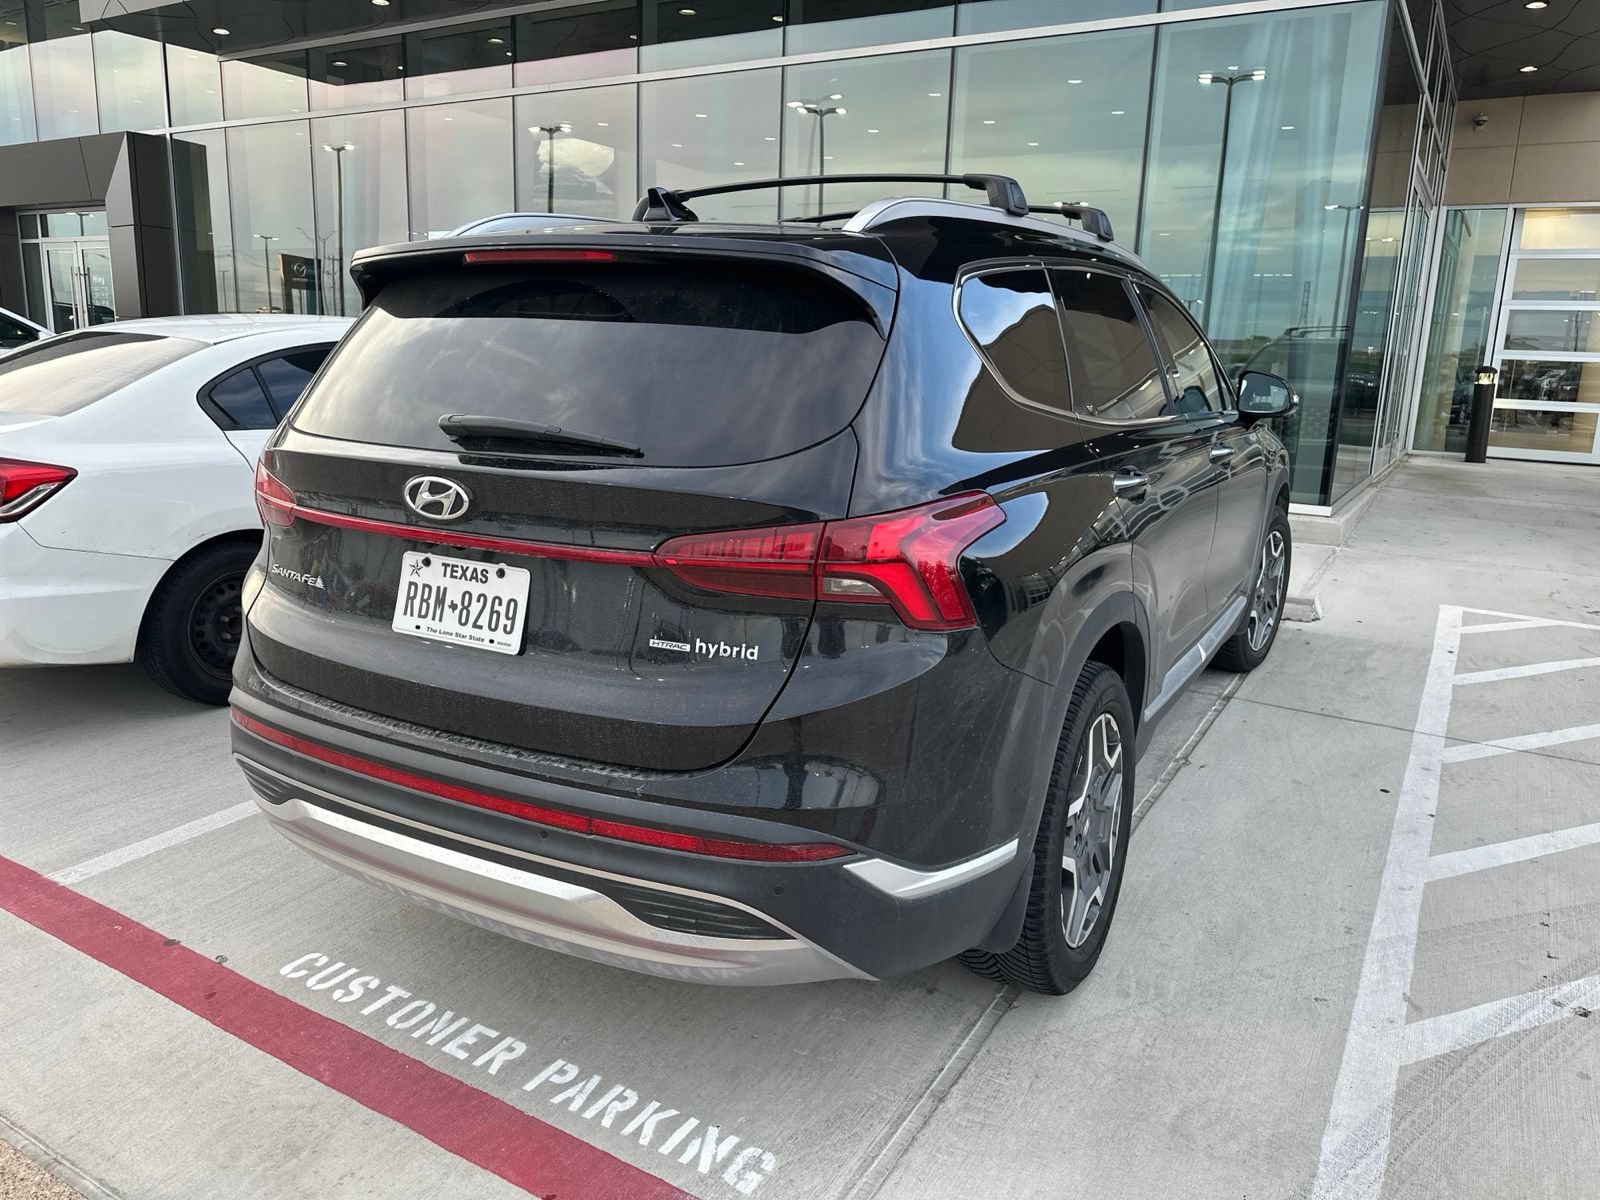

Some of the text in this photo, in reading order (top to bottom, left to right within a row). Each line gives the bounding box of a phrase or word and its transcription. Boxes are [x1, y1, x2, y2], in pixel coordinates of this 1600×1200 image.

[441, 562, 489, 584] TEXAS
[403, 581, 519, 635] RBM 8269
[426, 626, 485, 643] The Lone Star State
[651, 638, 759, 661] HTRAC hybrid
[522, 1058, 778, 1195] PARKING
